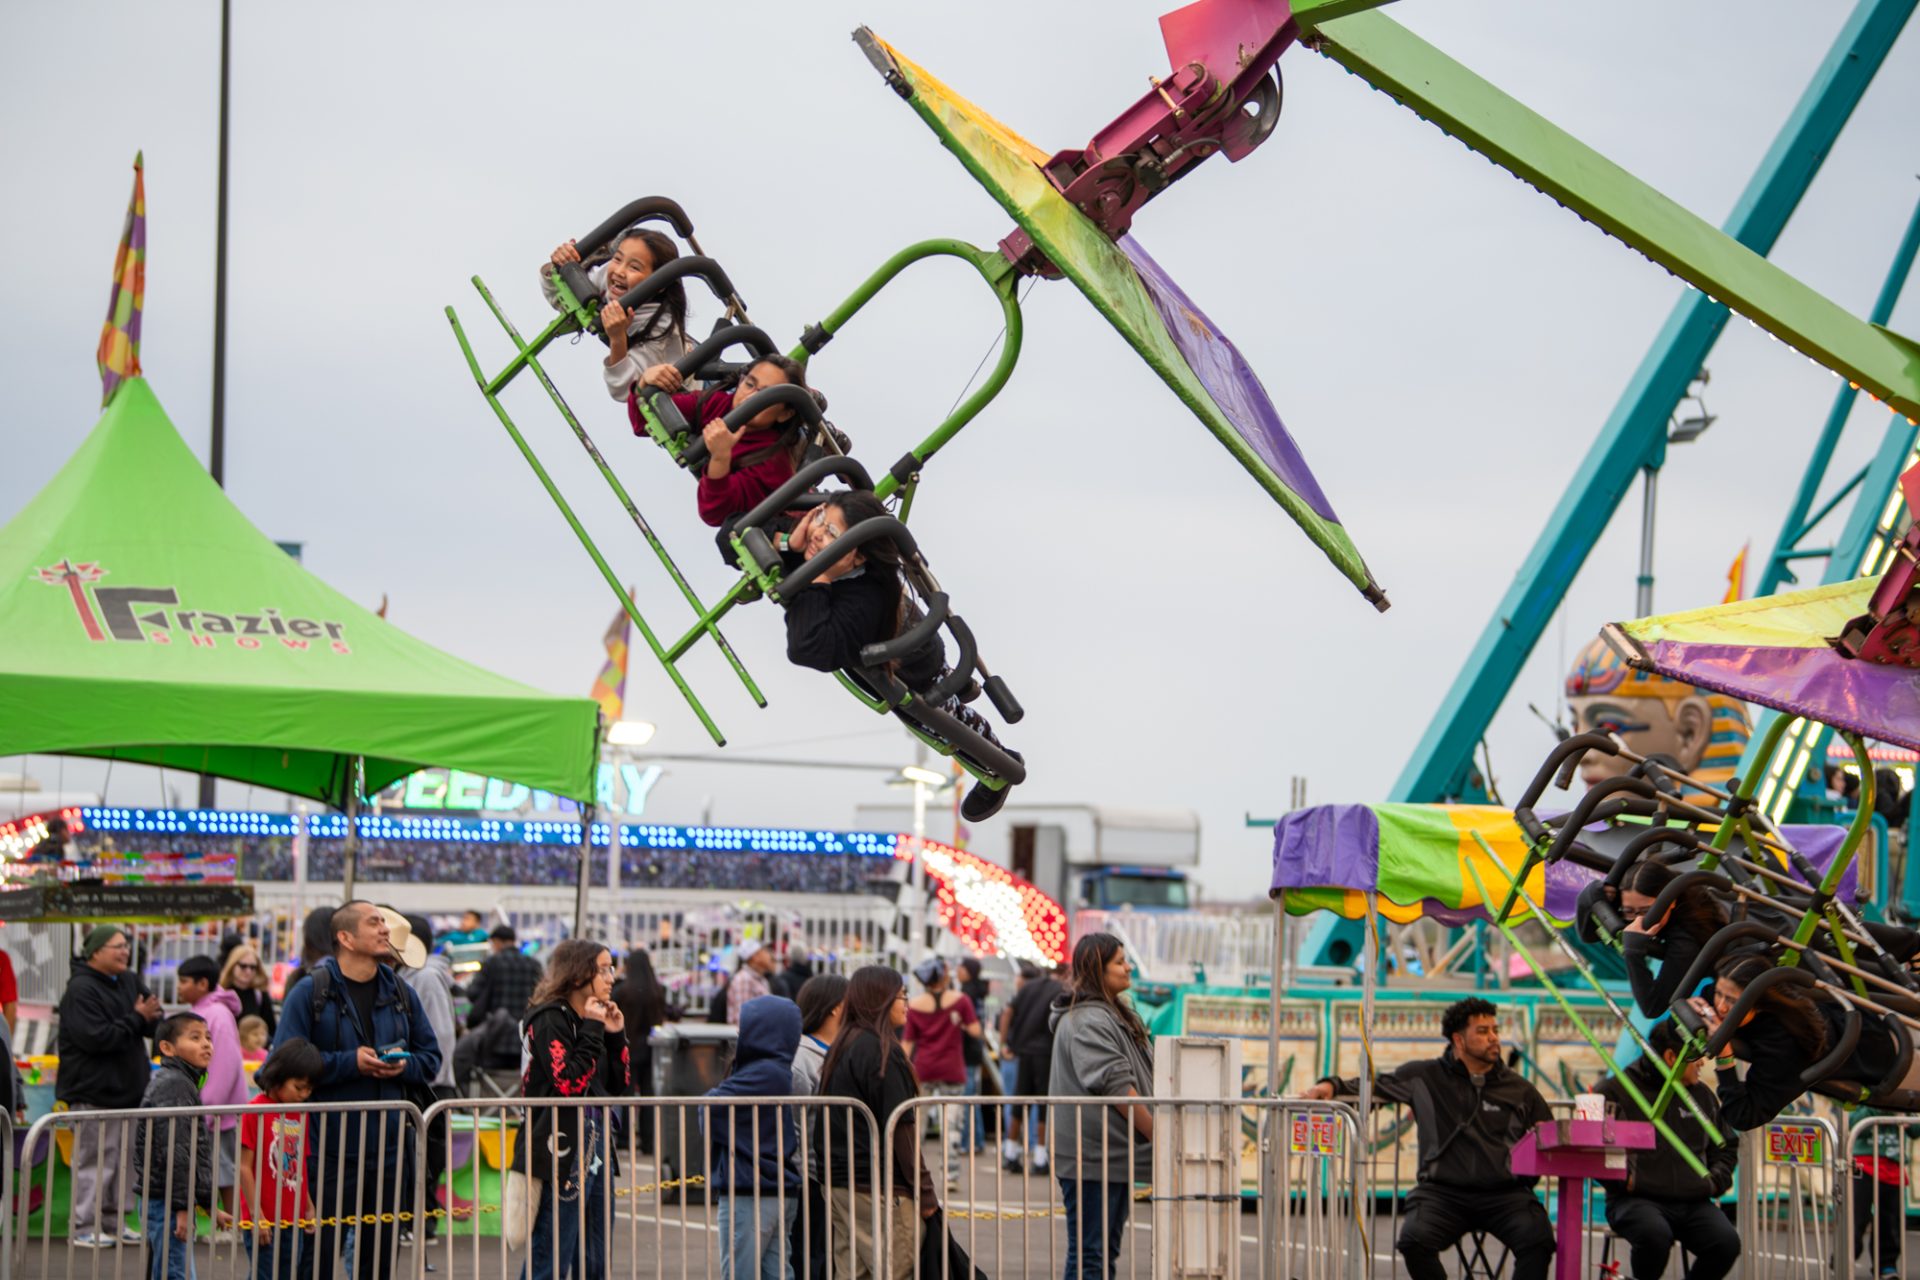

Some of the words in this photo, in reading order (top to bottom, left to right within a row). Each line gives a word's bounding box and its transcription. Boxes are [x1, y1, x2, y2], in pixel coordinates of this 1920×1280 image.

[93, 586, 345, 642] Frazier
[150, 630, 353, 656] SHOWS
[1769, 1131, 1817, 1156] EXIT
